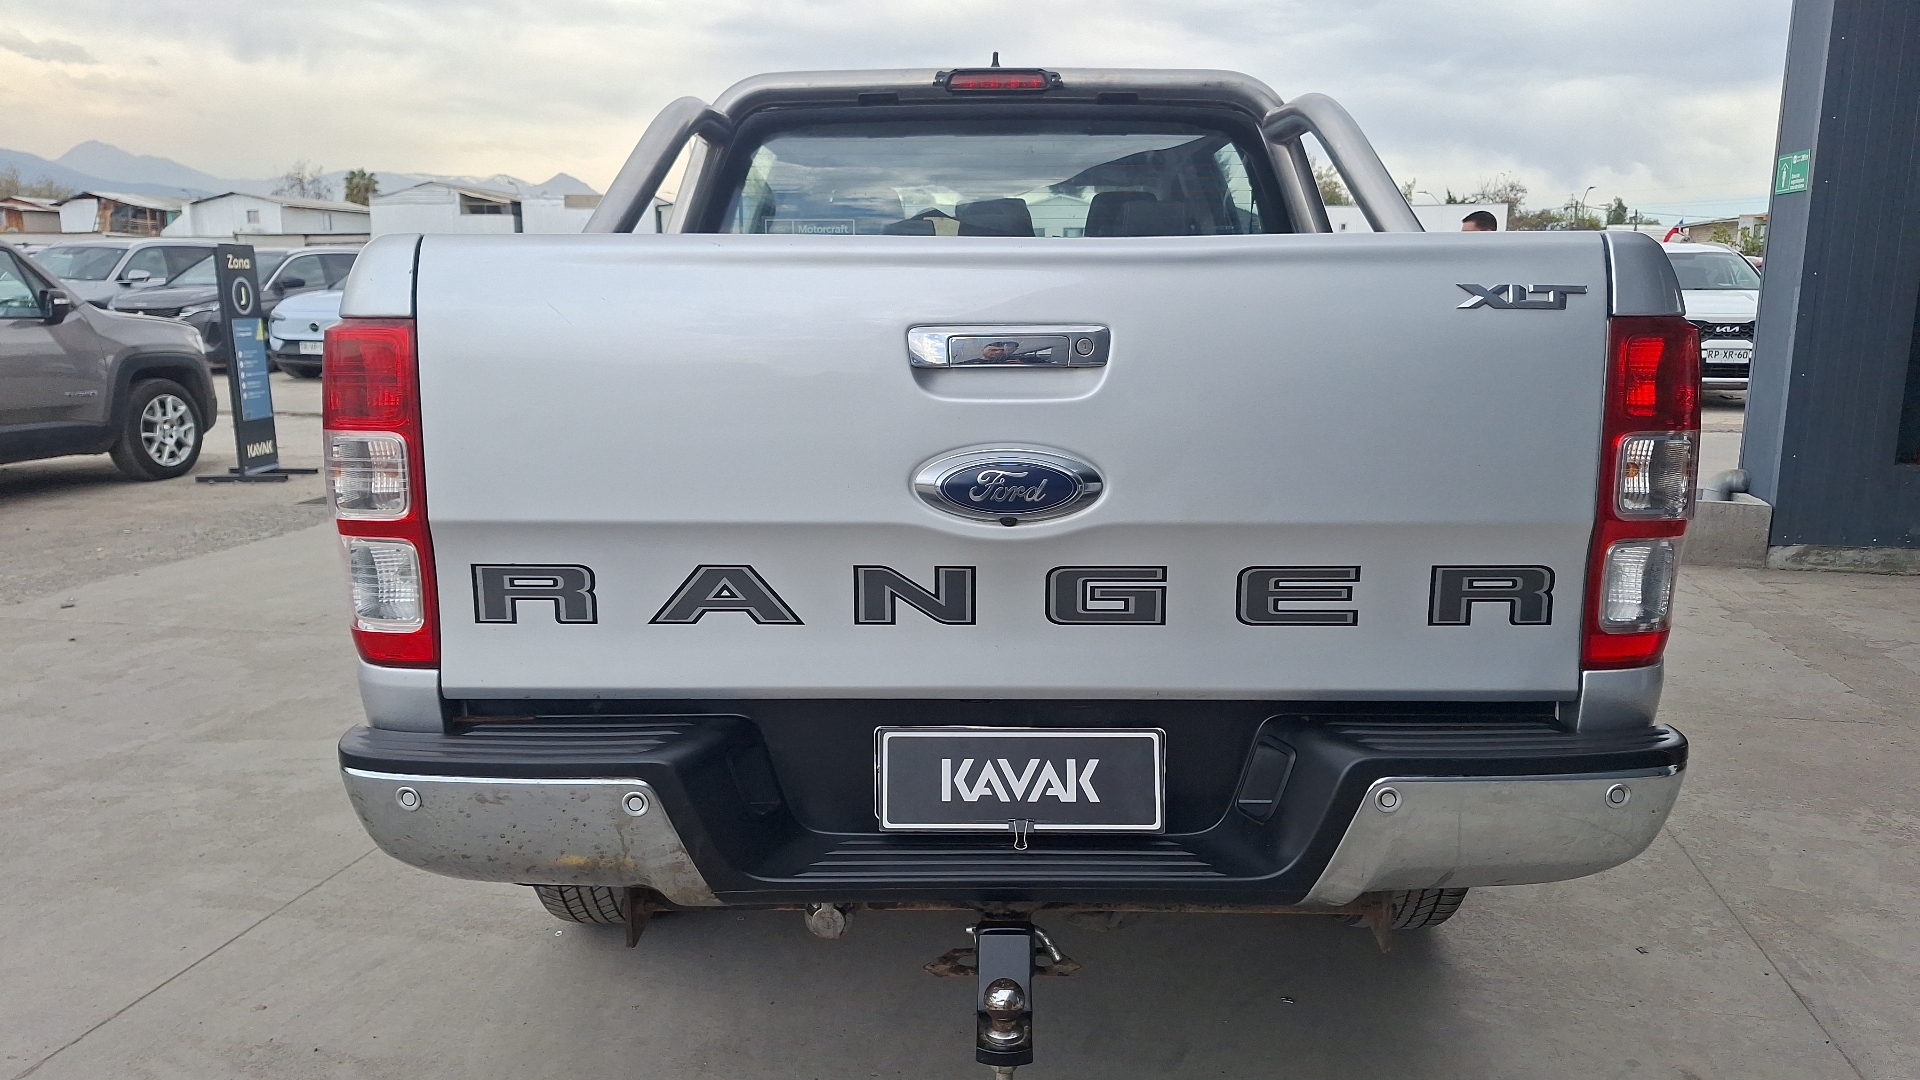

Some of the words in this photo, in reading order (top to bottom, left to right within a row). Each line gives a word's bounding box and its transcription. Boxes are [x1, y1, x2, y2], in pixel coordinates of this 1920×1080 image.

[798, 225, 849, 234] Motorcraft
[226, 254, 250, 269] Zona
[1455, 283, 1588, 310] XLT
[246, 440, 273, 458] KAVAK
[968, 469, 1049, 502] Ford
[470, 563, 1556, 626] RANGER
[941, 758, 1101, 803] KAVAK
